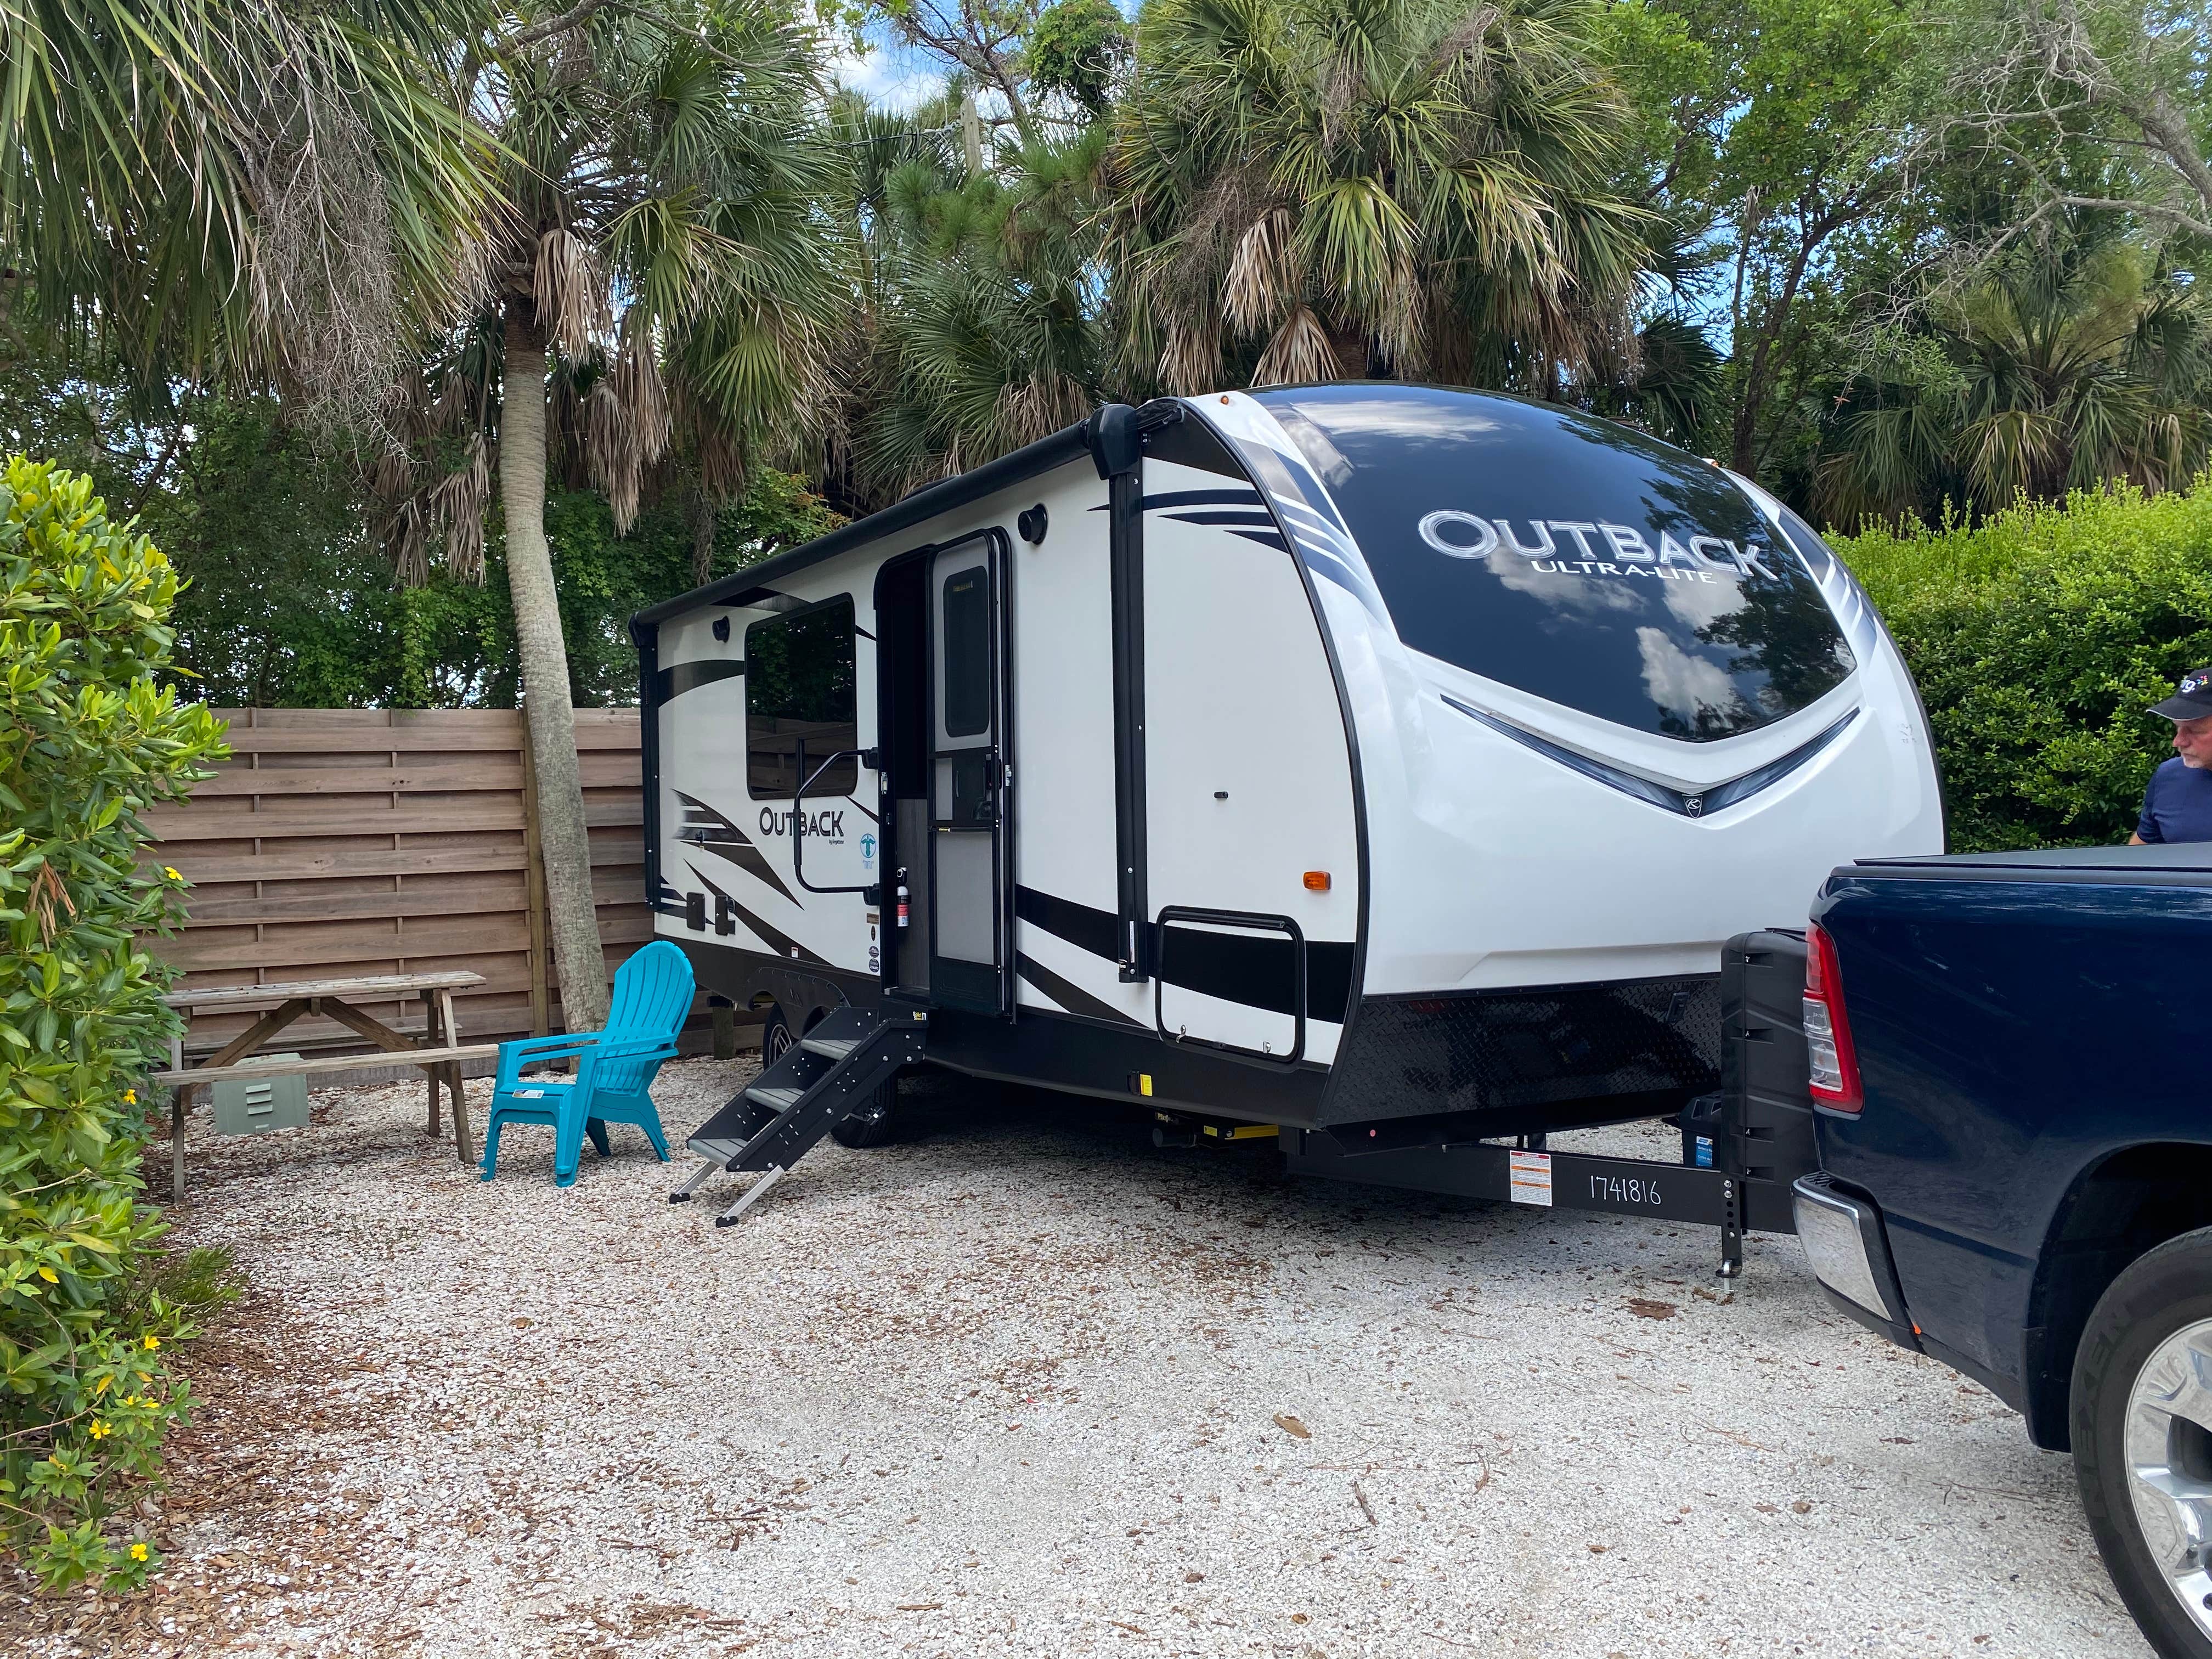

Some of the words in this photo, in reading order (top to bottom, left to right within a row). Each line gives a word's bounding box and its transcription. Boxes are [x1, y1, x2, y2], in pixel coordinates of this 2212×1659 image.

[1418, 509, 1779, 581] OUTBACK
[1531, 561, 1717, 584] ULTRA-LITE
[759, 807, 844, 837] OUTBACK
[1591, 1175, 1661, 1205] 1741816
